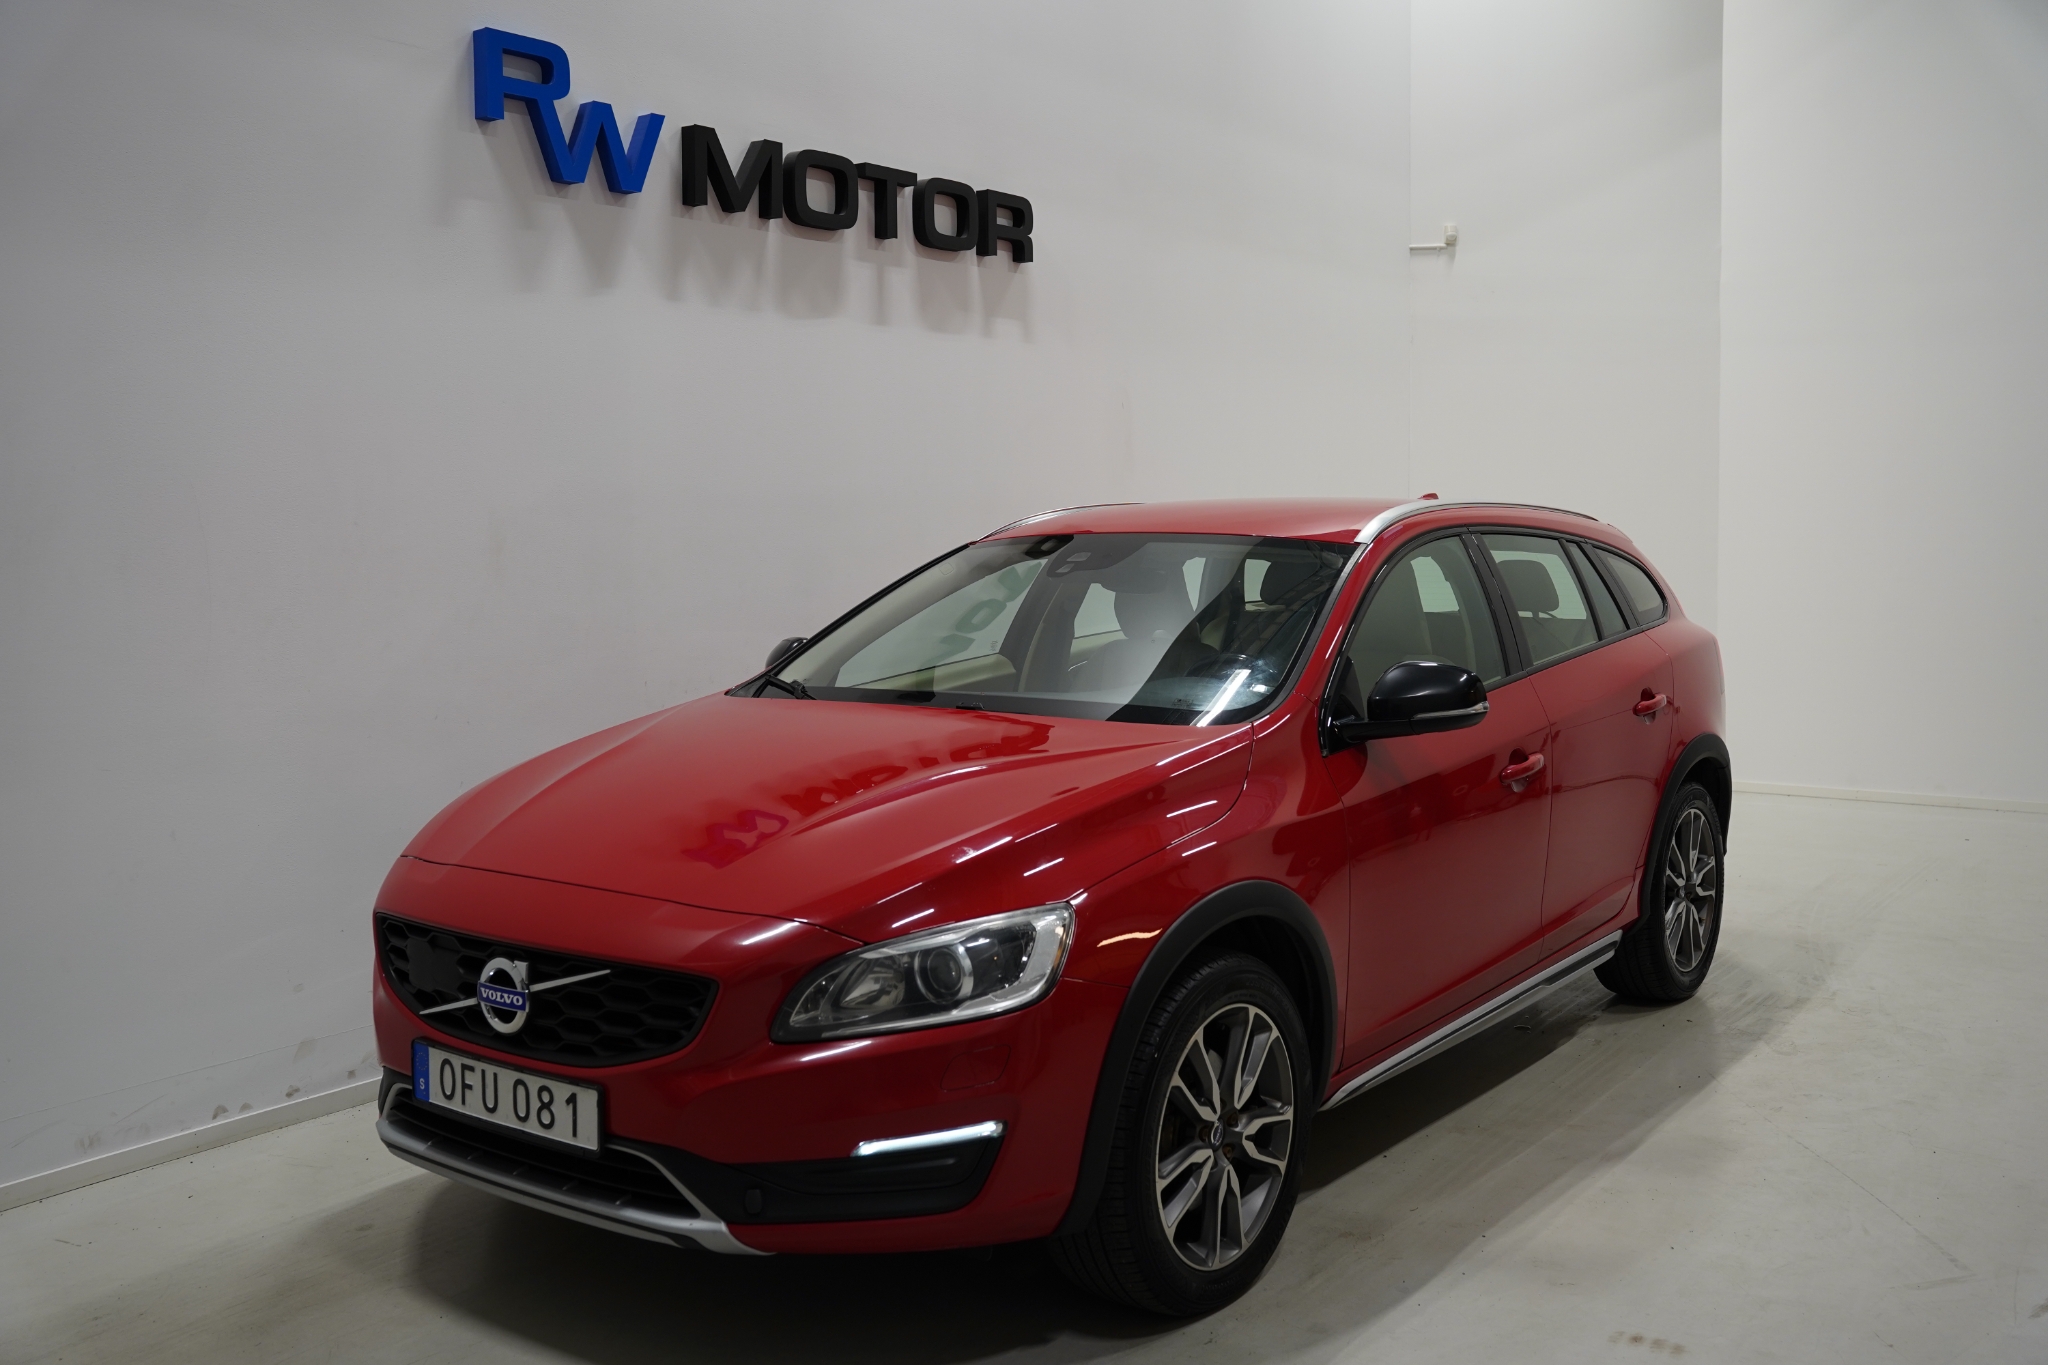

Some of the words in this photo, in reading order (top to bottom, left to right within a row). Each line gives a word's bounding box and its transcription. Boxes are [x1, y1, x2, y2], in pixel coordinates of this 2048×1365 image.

[473, 27, 666, 195] RW
[681, 124, 1034, 263] MOTOR
[480, 987, 523, 1006] VOLVO
[419, 1078, 425, 1090] S
[440, 1058, 499, 1114] OFU
[513, 1078, 578, 1138] 081
